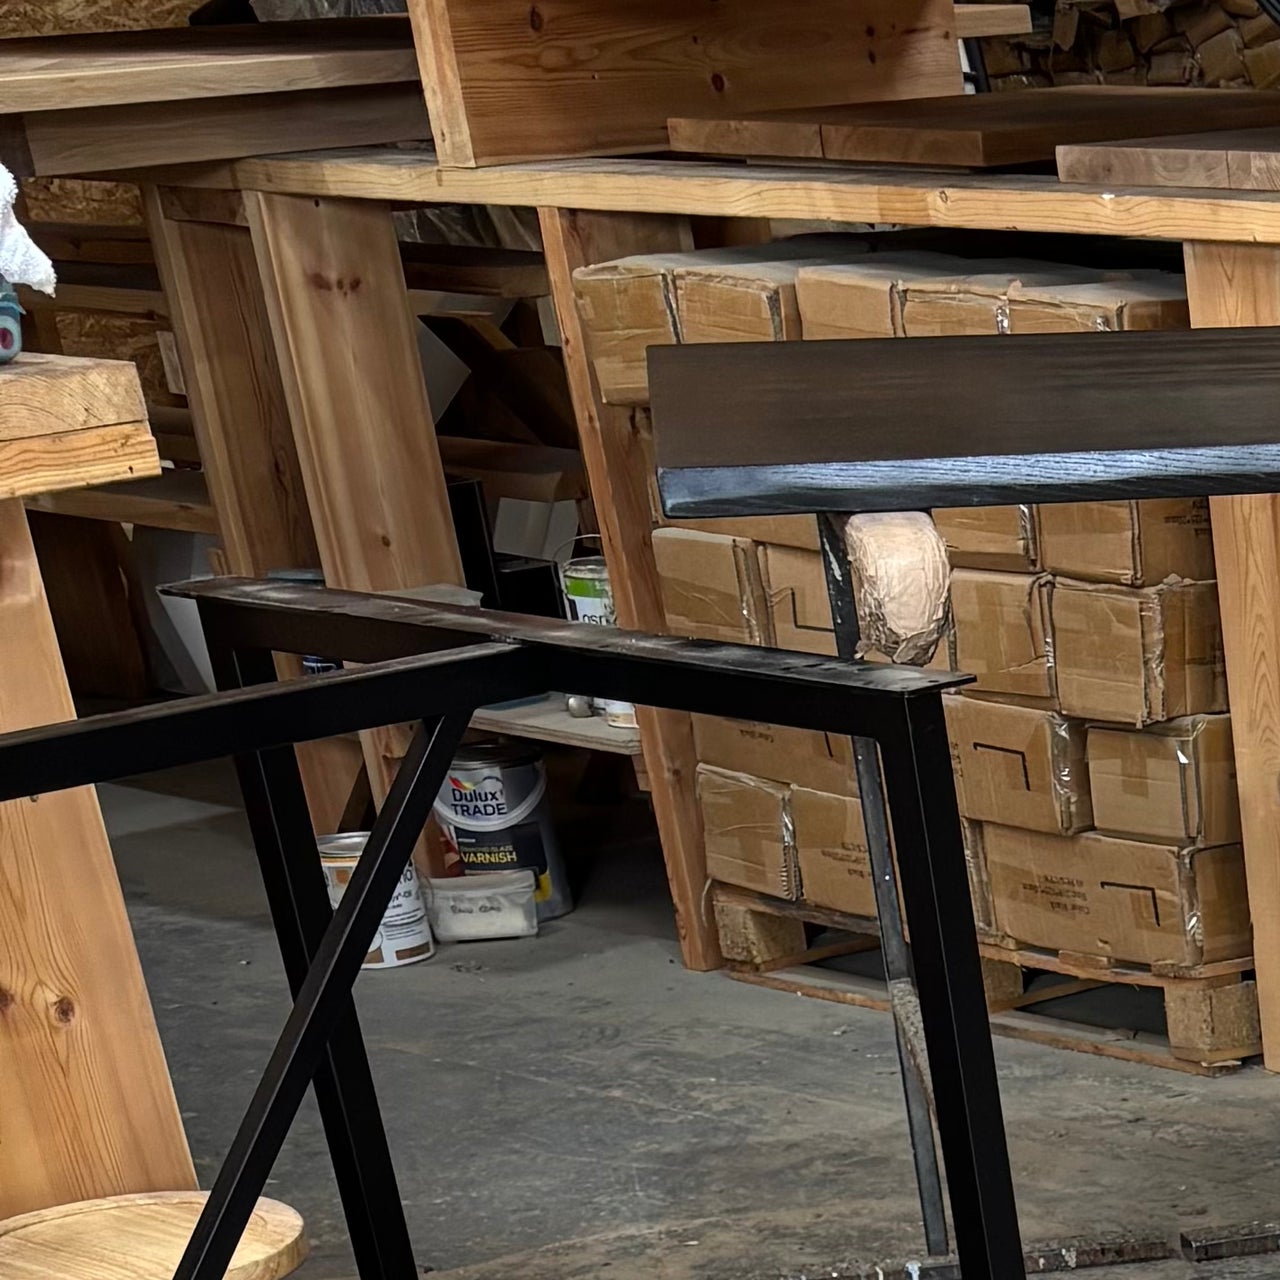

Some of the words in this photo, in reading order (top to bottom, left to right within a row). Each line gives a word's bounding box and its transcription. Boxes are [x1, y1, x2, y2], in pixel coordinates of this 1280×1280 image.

[451, 788, 499, 802] Dulux
[451, 803, 508, 816] TRADE
[461, 851, 517, 863] VARNISH
